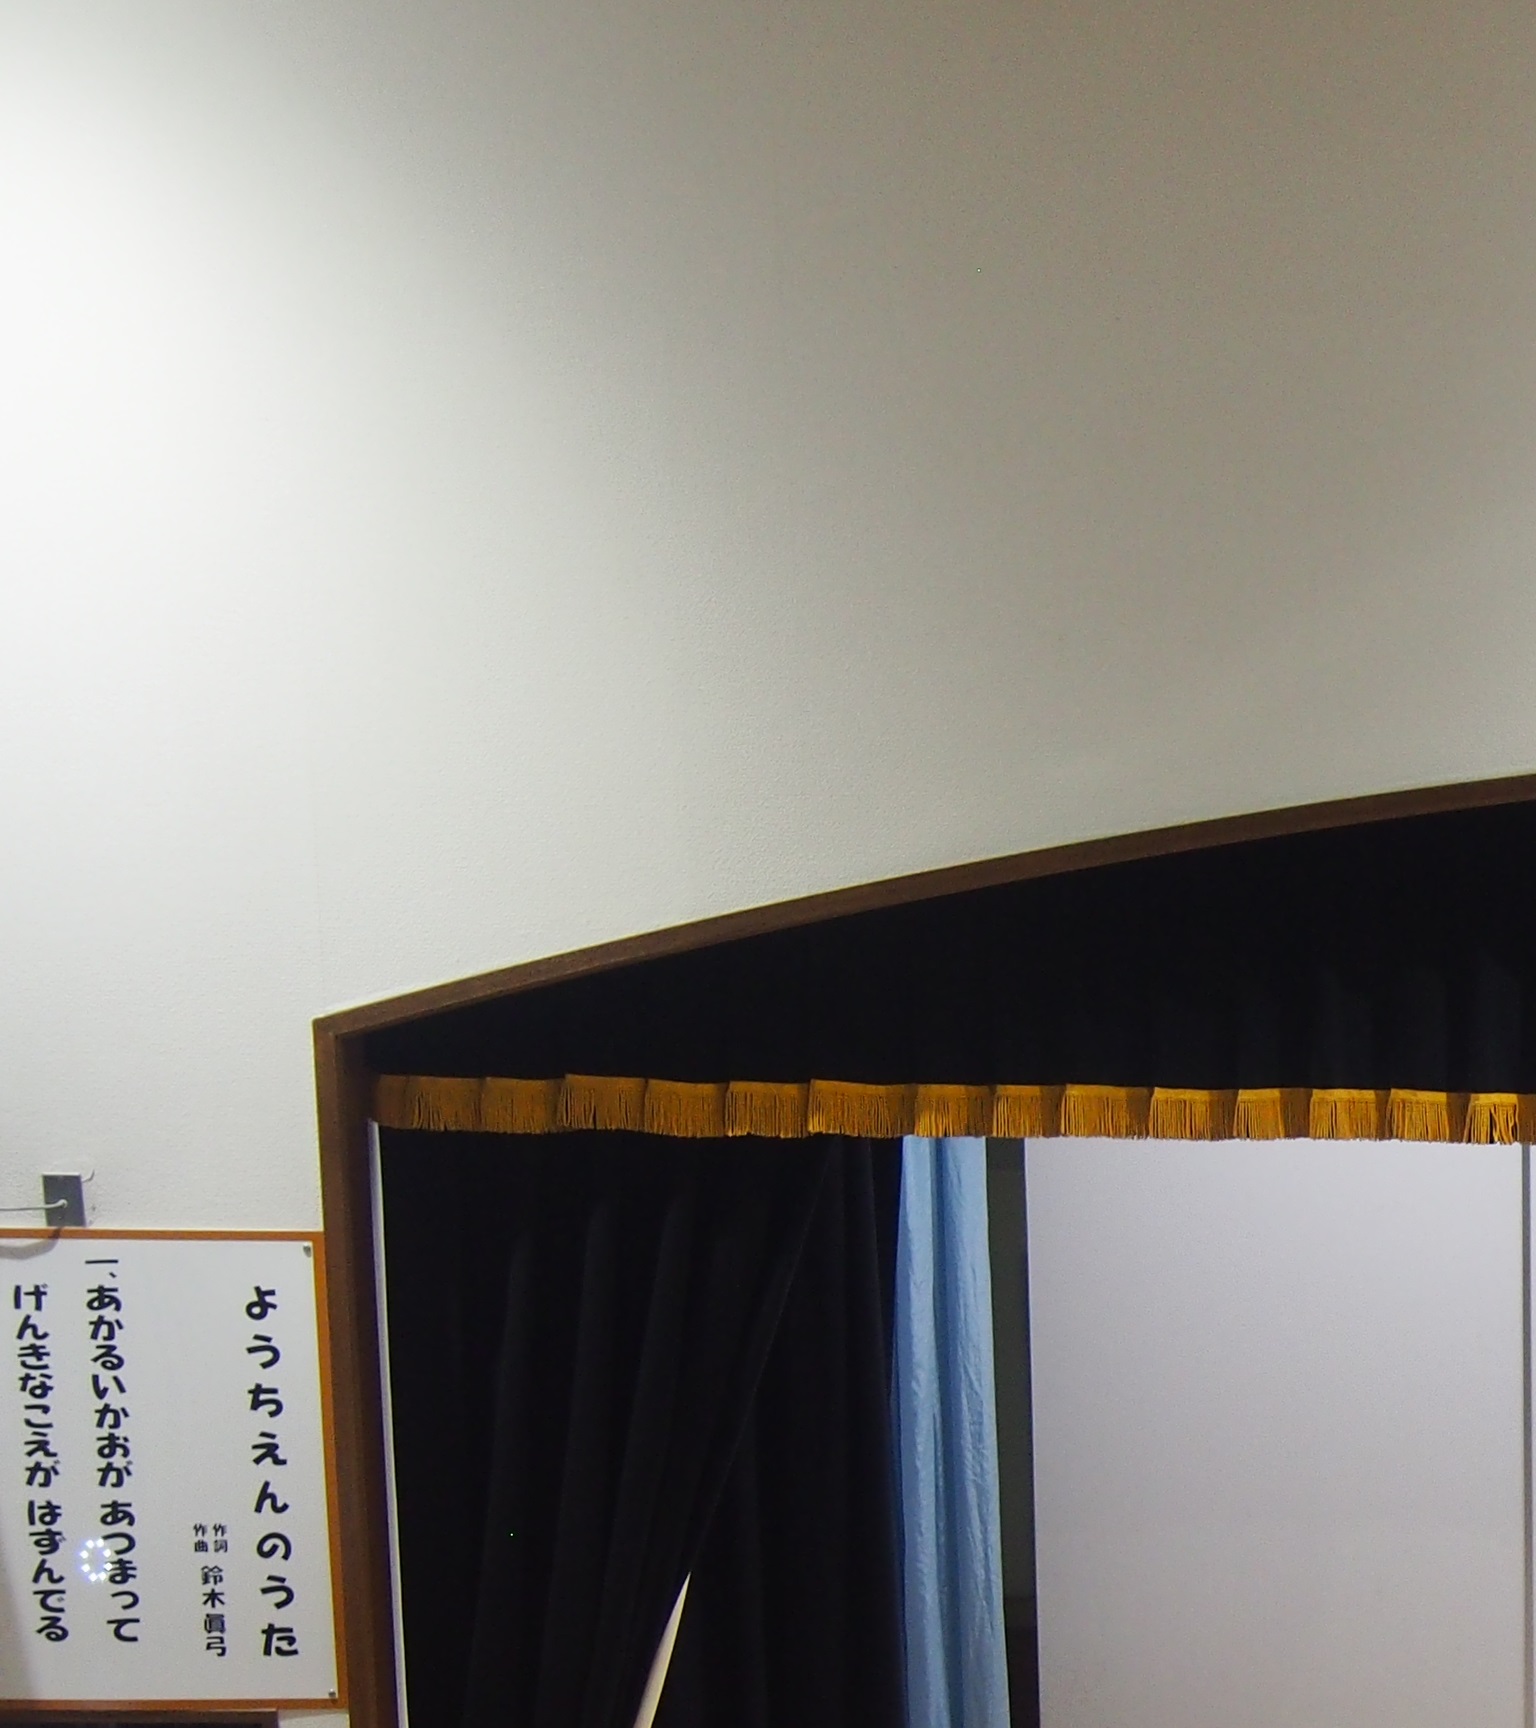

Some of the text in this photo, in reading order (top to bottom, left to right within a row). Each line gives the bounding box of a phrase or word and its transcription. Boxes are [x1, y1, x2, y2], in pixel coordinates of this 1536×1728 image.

[13, 1284, 70, 1643] げんきなこえが はずんでる
[245, 1285, 299, 1658] ようちえんのうた
[99, 1499, 140, 1643] あつまって
[193, 1523, 209, 1553] 作曲
[213, 1523, 228, 1553] 作詞
